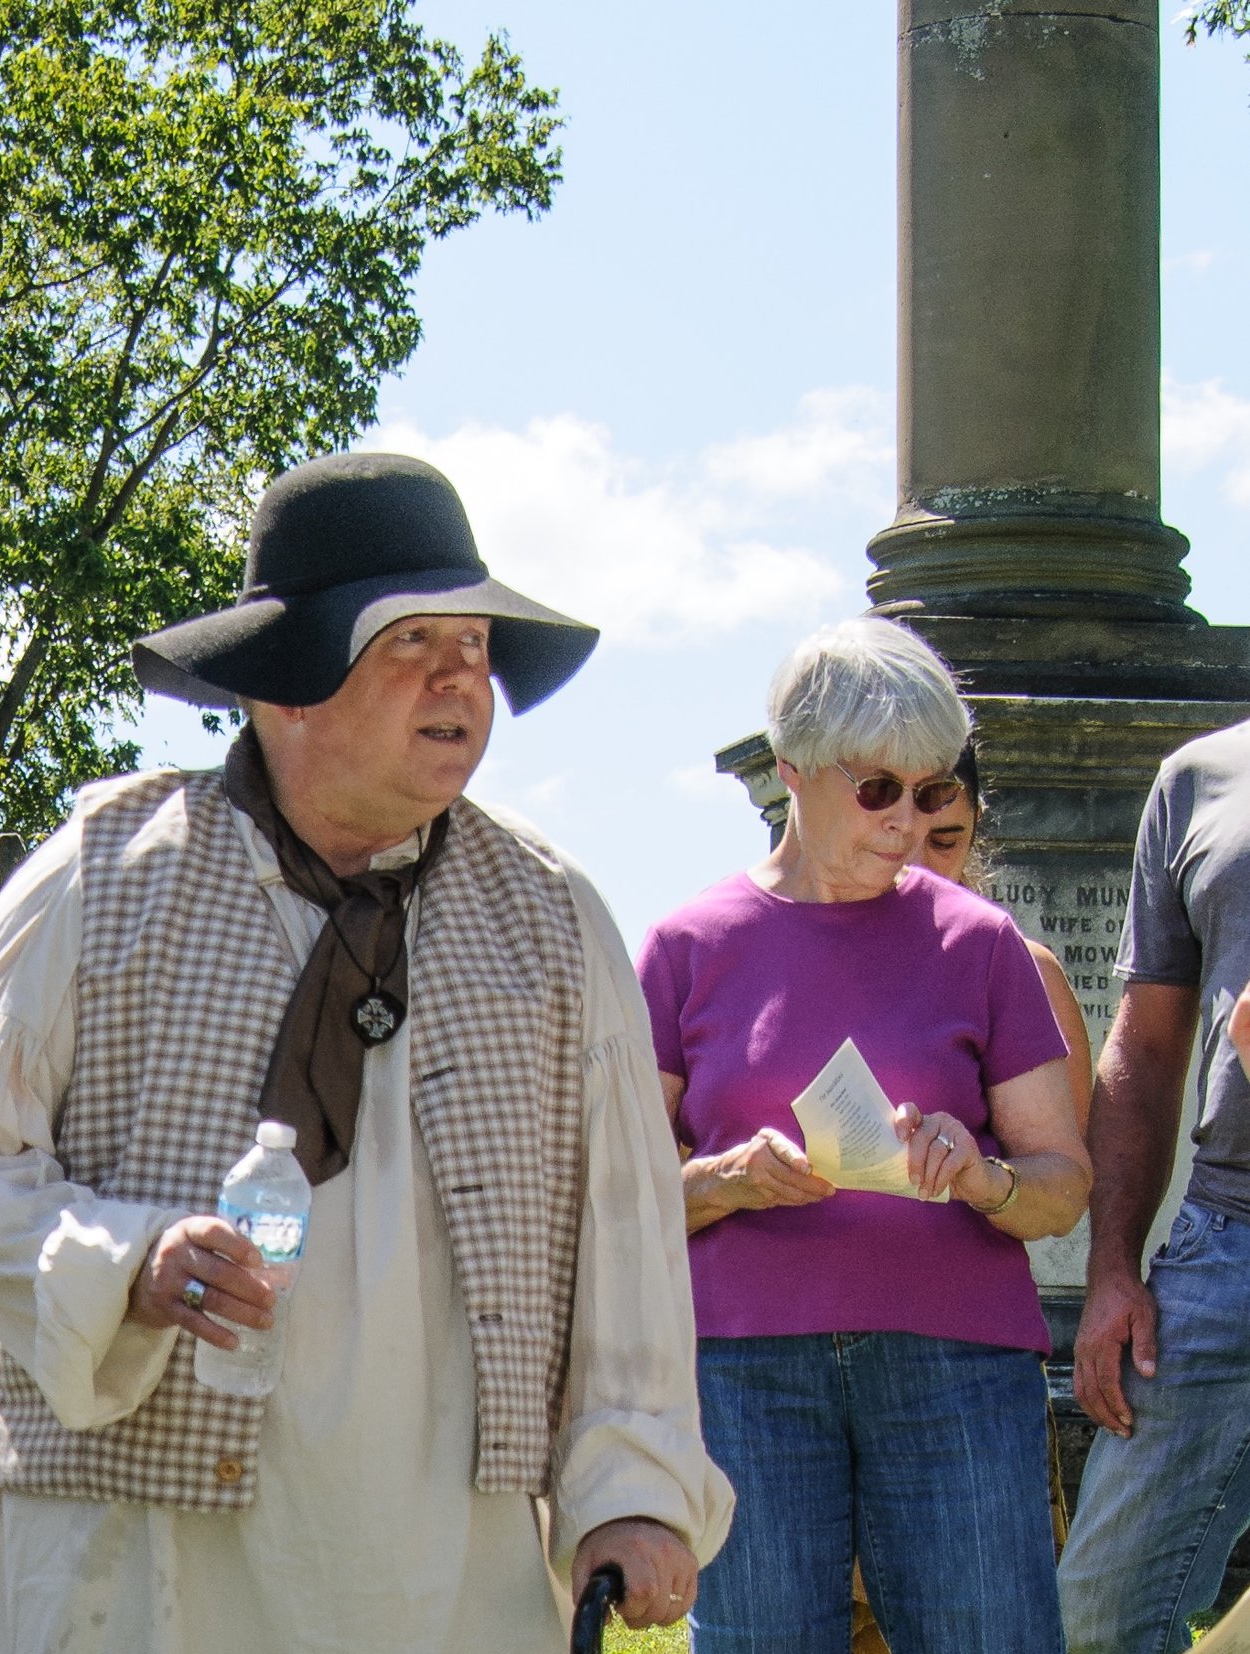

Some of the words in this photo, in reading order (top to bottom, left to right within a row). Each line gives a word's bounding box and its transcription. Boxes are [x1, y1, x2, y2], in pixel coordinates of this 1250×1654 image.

[991, 884, 1058, 906] LUCY
[1040, 916, 1091, 933] WIFE
[1064, 945, 1118, 962] MOW
[1067, 975, 1109, 990] IED
